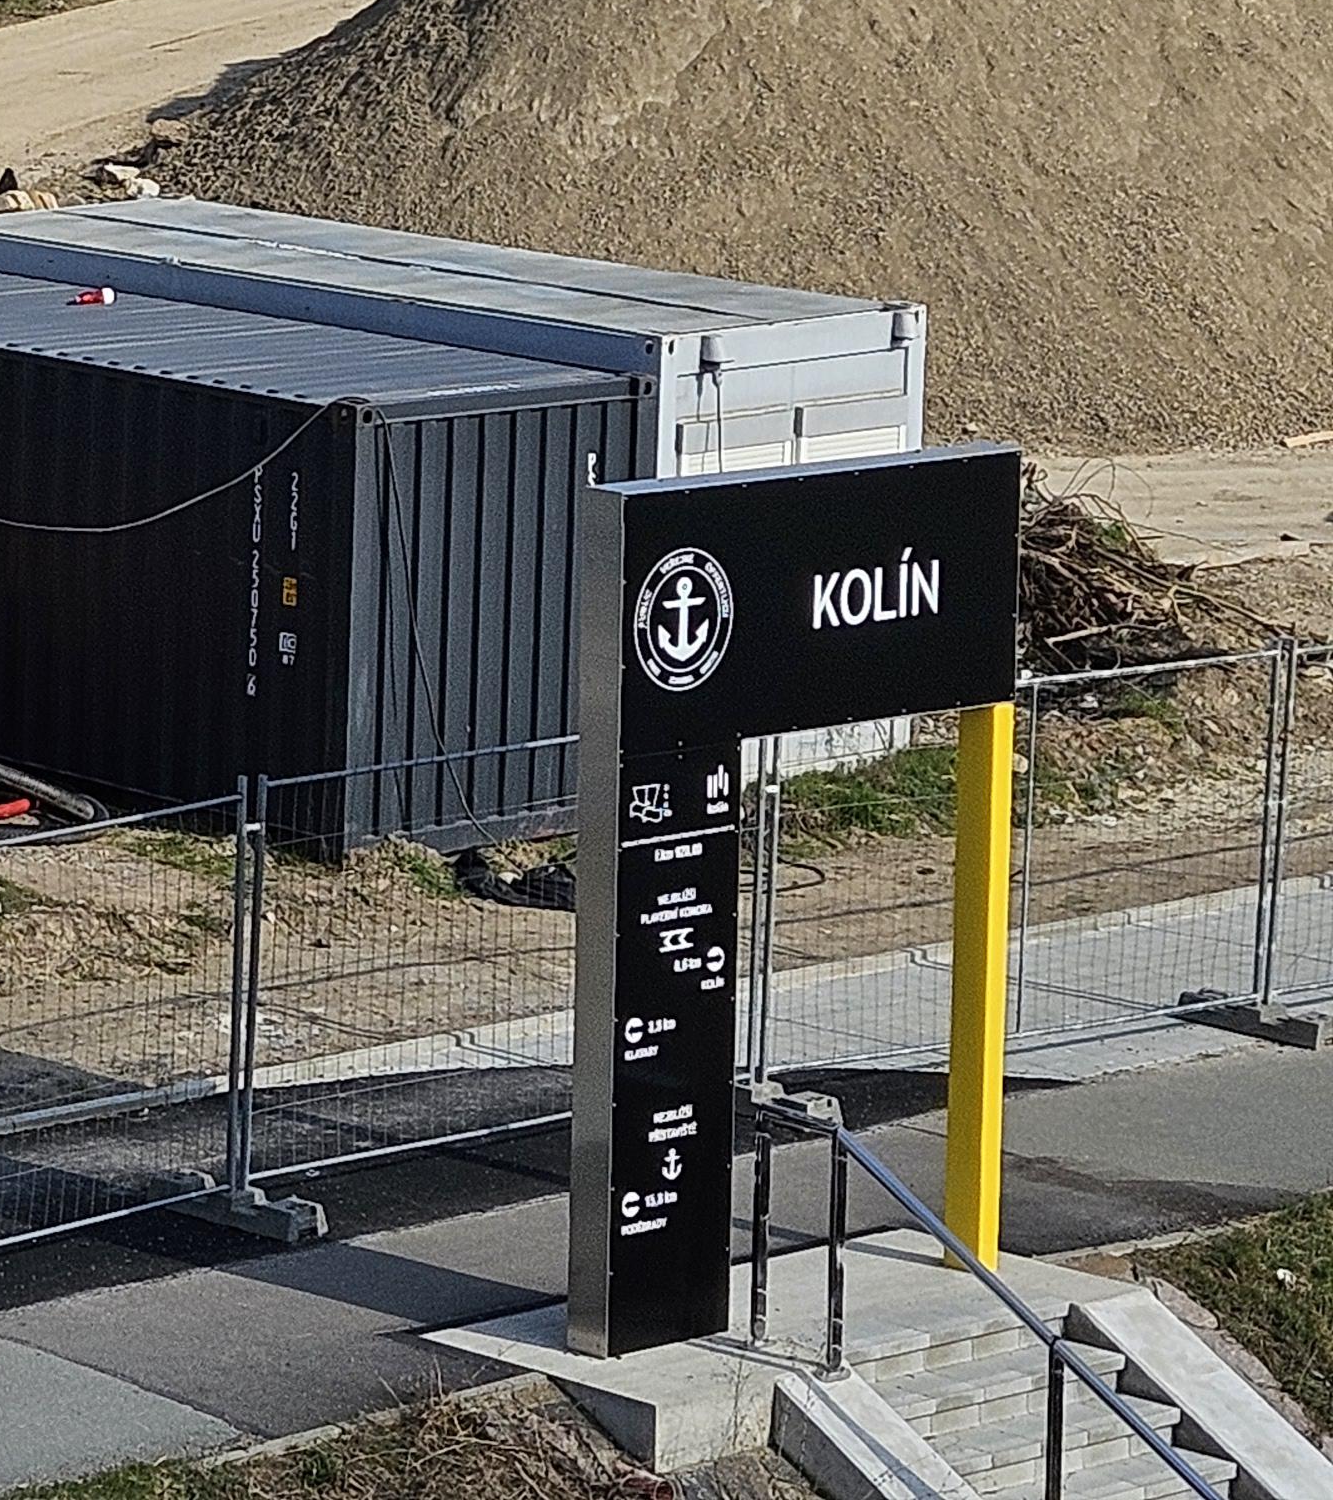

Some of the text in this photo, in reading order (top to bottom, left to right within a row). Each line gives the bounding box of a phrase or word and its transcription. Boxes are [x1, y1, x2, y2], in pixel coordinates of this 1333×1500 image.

[252, 464, 263, 543] PSXU
[290, 471, 299, 551] 22G1
[248, 549, 260, 667] 250750
[812, 546, 940, 630] KOLÍN
